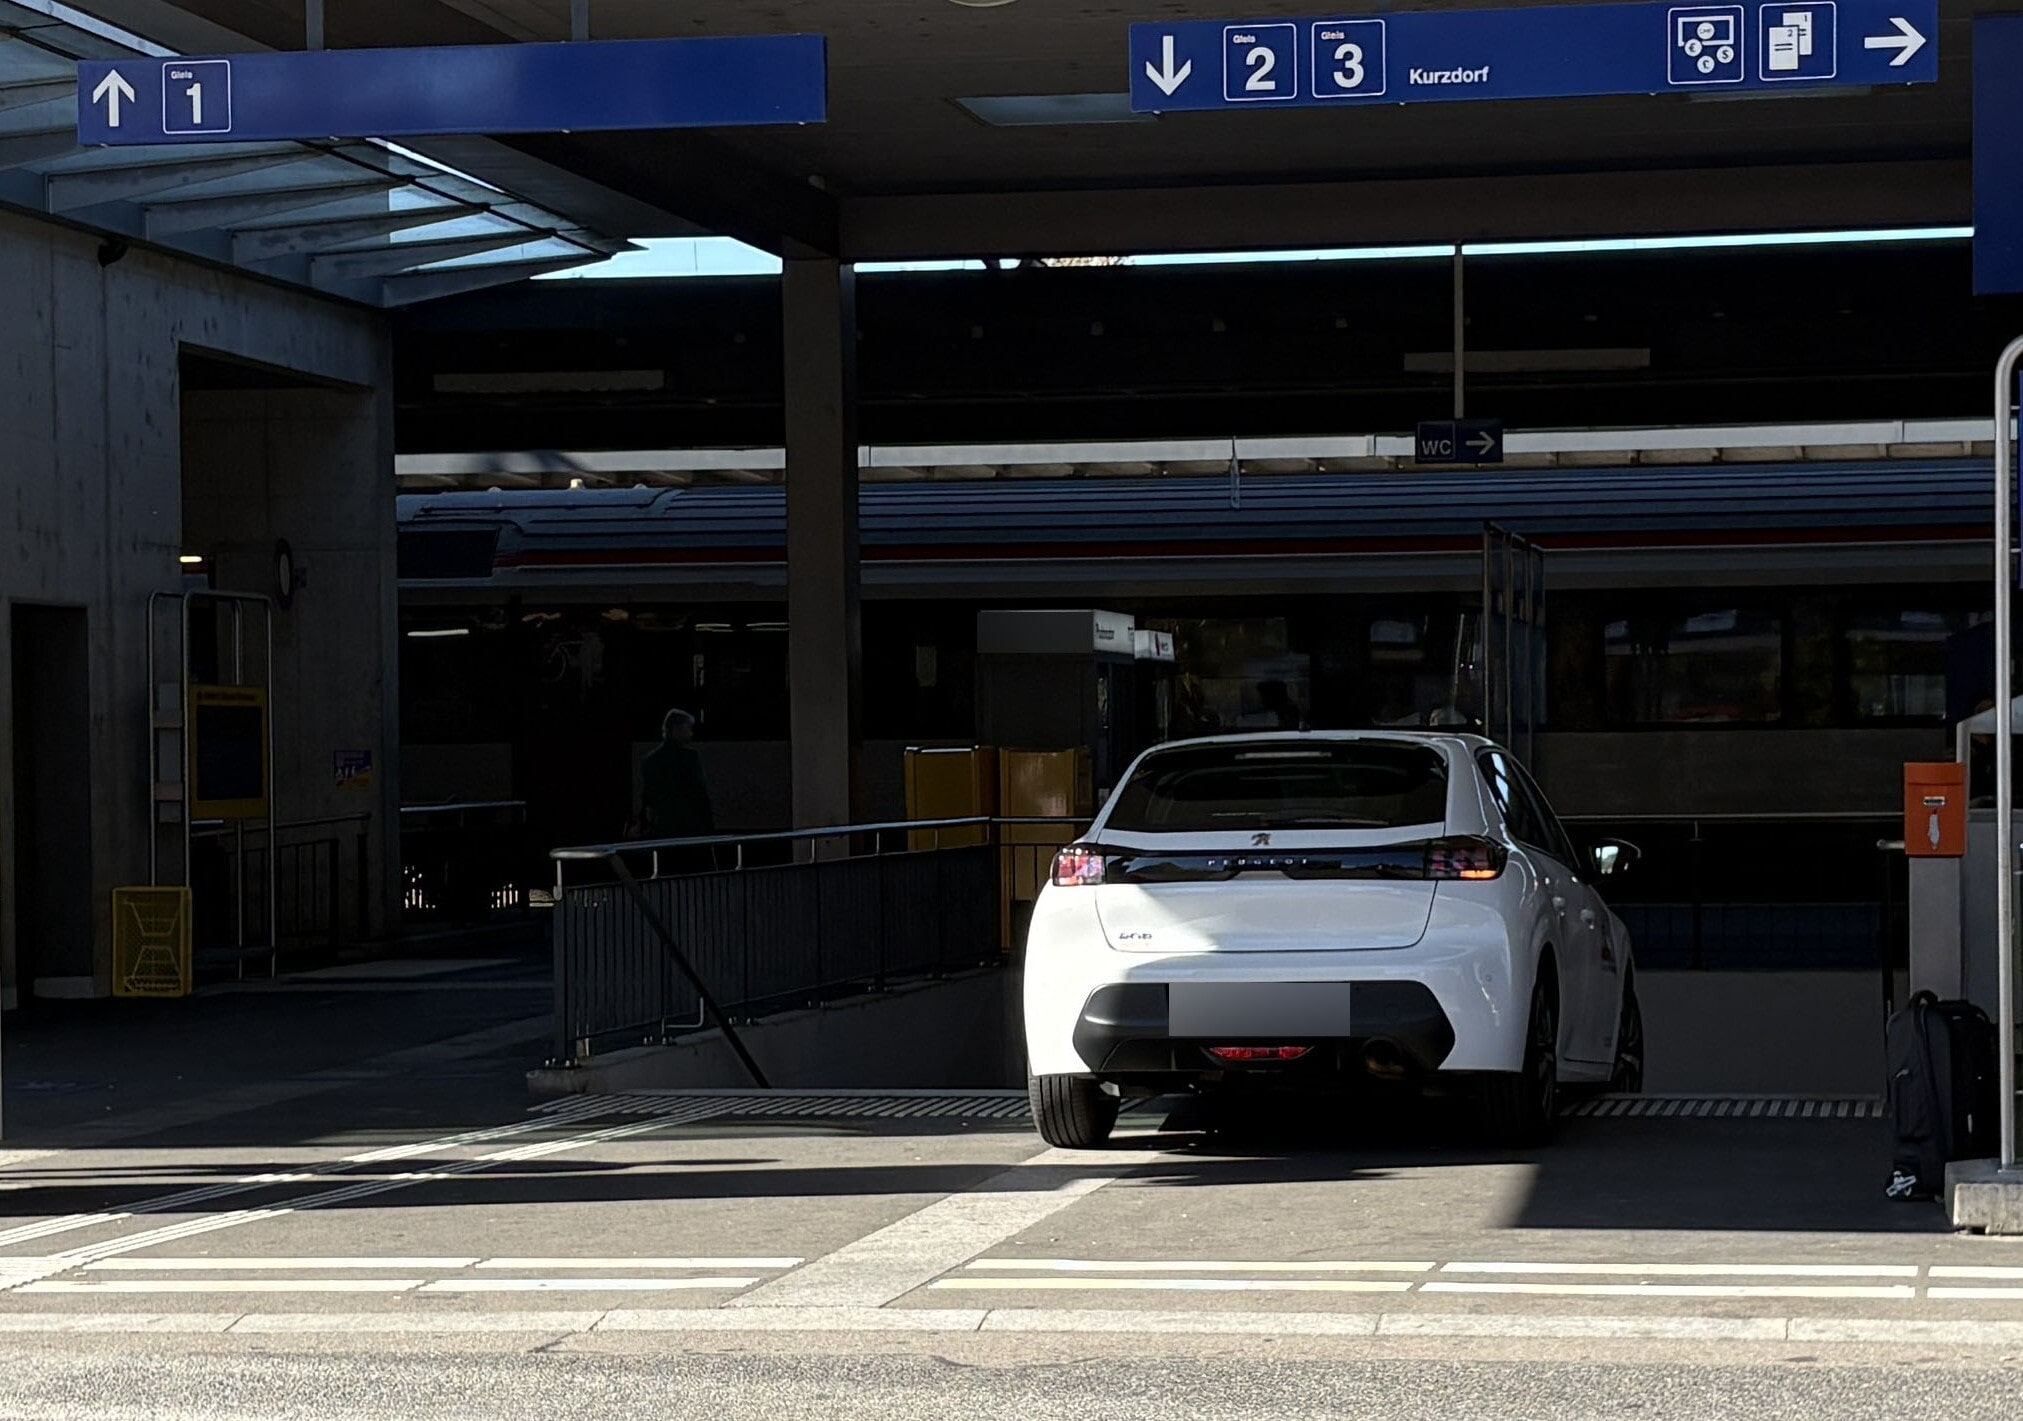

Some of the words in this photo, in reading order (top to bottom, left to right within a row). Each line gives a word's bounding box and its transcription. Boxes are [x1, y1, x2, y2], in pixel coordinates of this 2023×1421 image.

[1232, 34, 1256, 43] Gleis
[1320, 31, 1345, 40] Gleis
[1245, 46, 1276, 91] 2
[1333, 43, 1365, 89] 3
[1409, 66, 1489, 85] Kurzdorf
[185, 82, 202, 124] 1
[1421, 439, 1452, 456] WC
